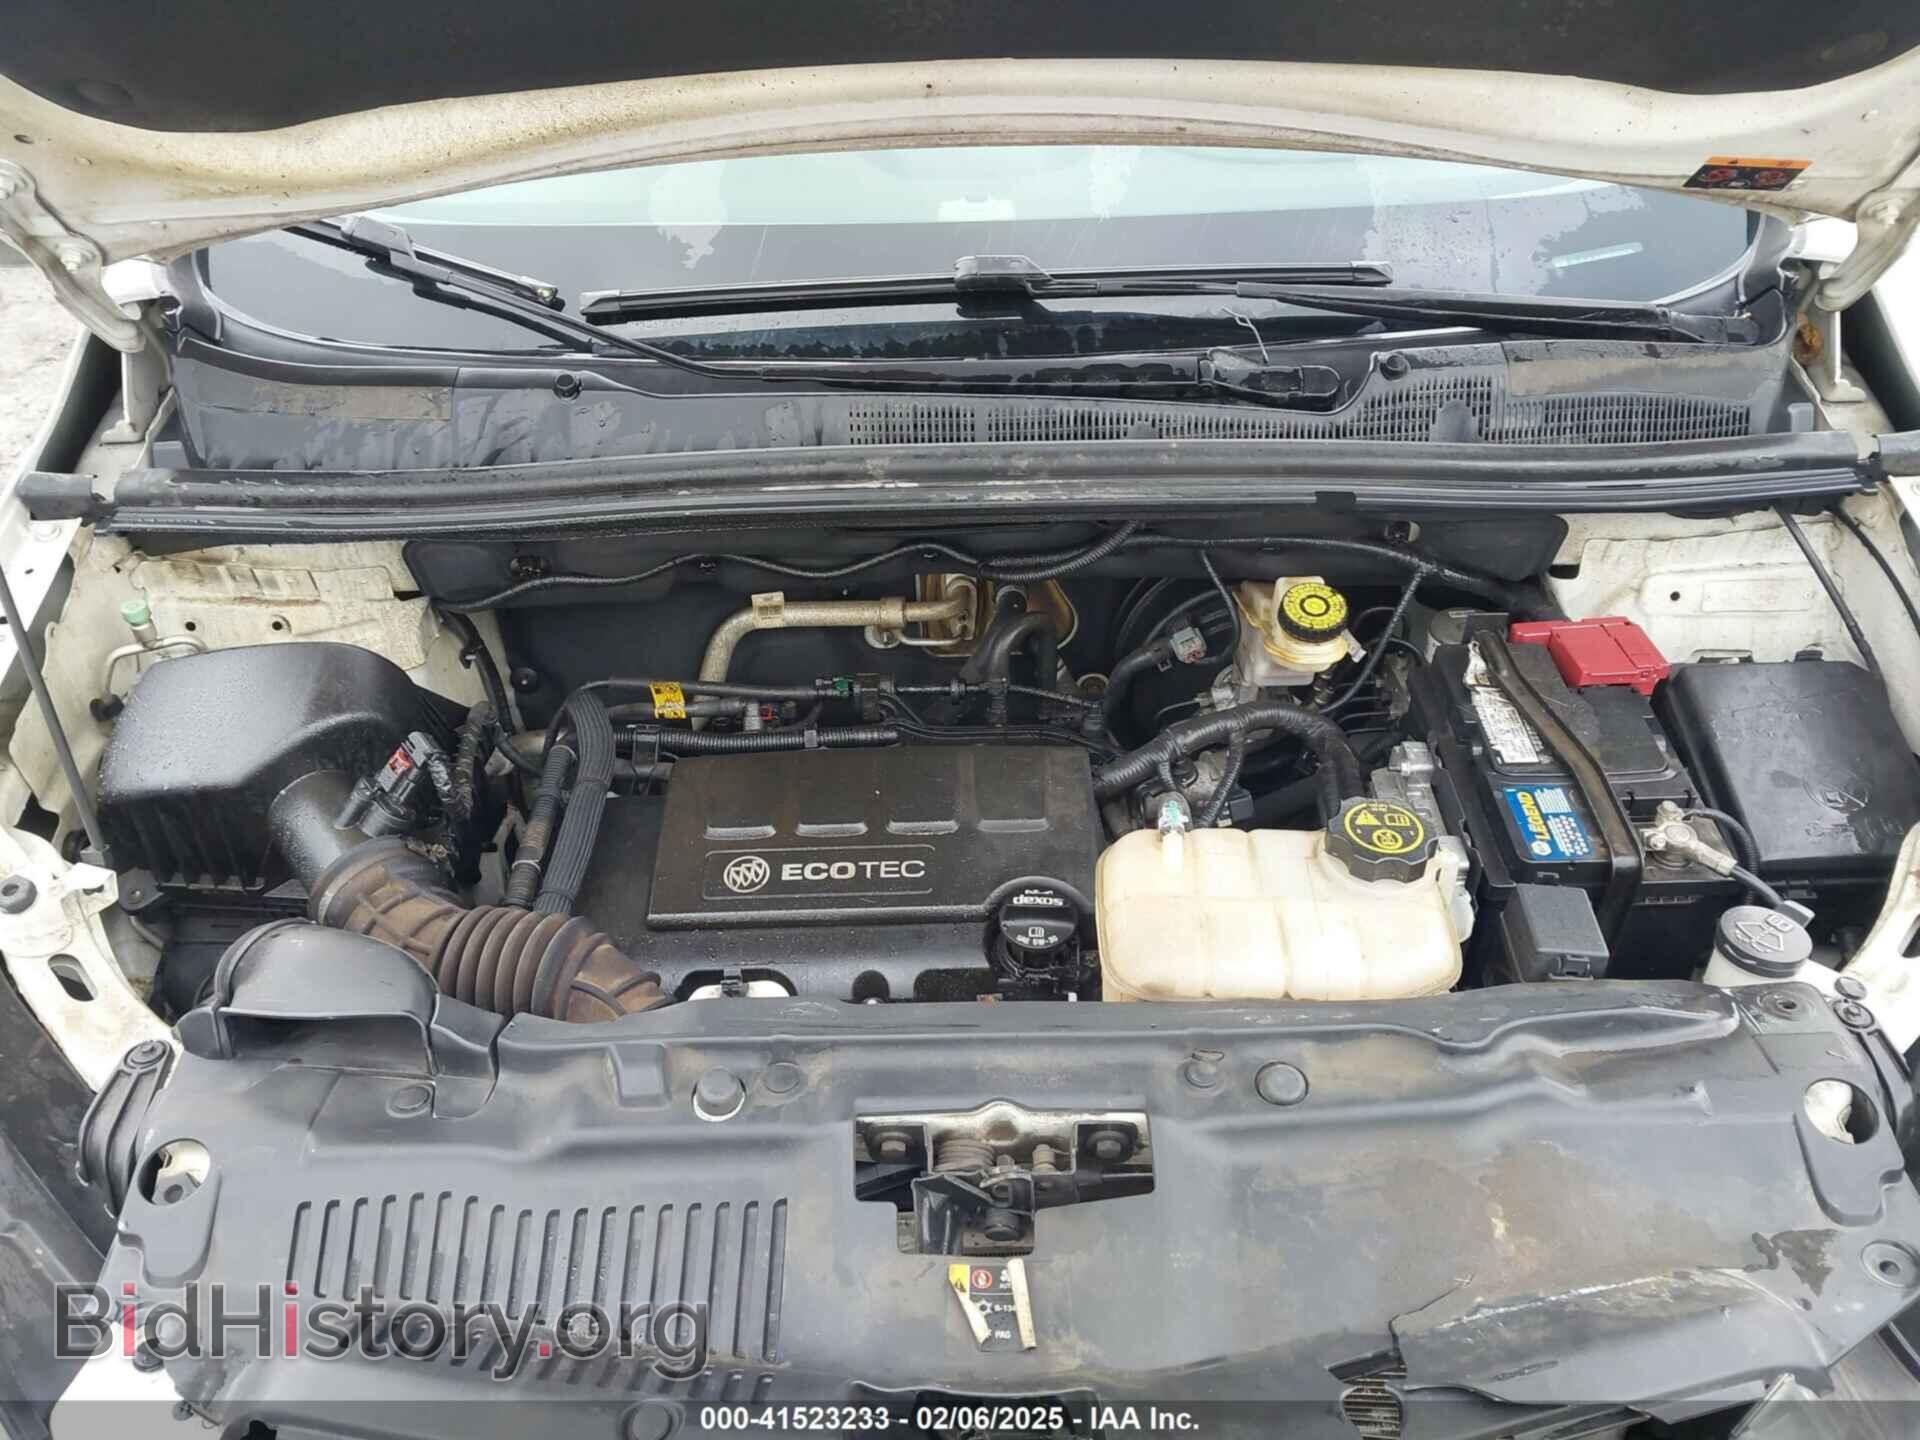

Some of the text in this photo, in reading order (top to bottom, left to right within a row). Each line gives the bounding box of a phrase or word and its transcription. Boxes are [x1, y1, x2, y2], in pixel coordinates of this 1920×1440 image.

[1517, 791, 1551, 841] LEGEND
[780, 860, 926, 881] ECOTEC
[1012, 893, 1065, 906] dexos
